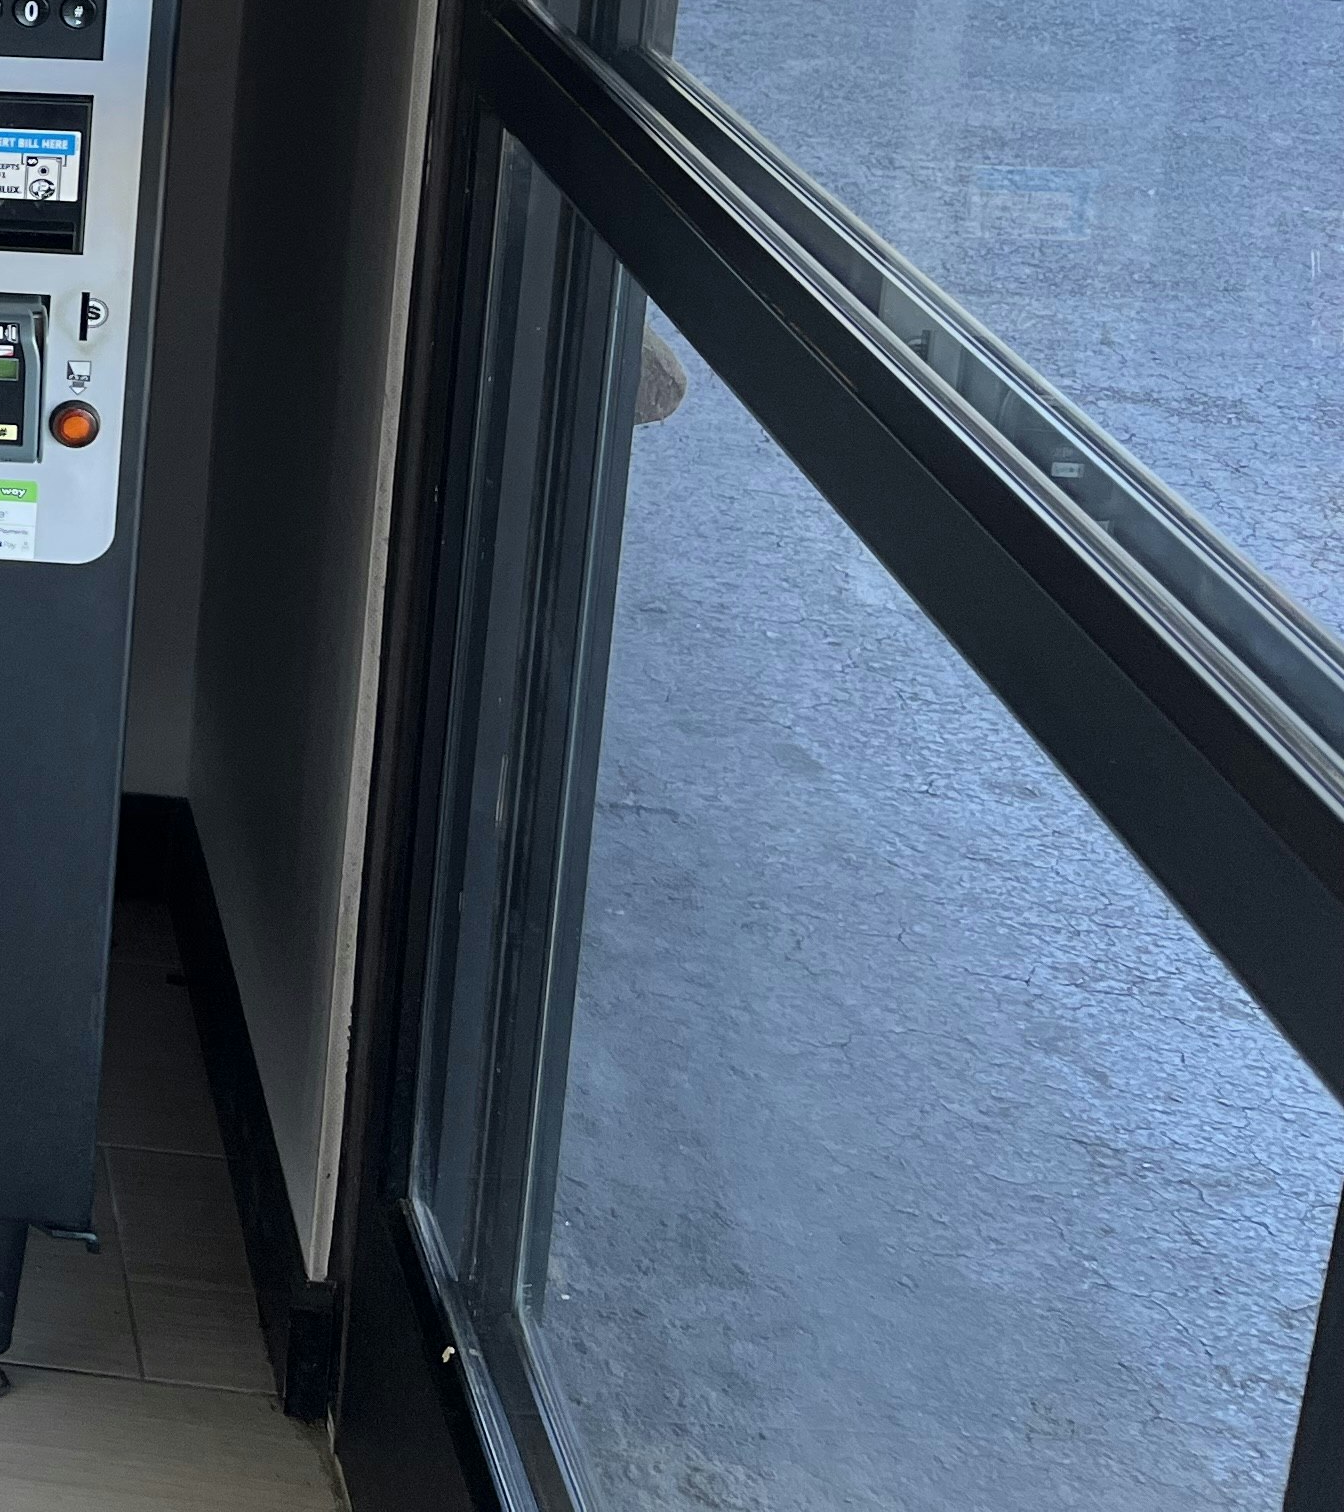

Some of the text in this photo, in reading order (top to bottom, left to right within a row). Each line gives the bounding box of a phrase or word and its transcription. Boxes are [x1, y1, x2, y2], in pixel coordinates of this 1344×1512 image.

[24, 0, 39, 22] 0
[74, 5, 84, 18] #
[18, 138, 39, 148] BILL
[41, 140, 68, 149] HERE
[1, 488, 26, 498] way
